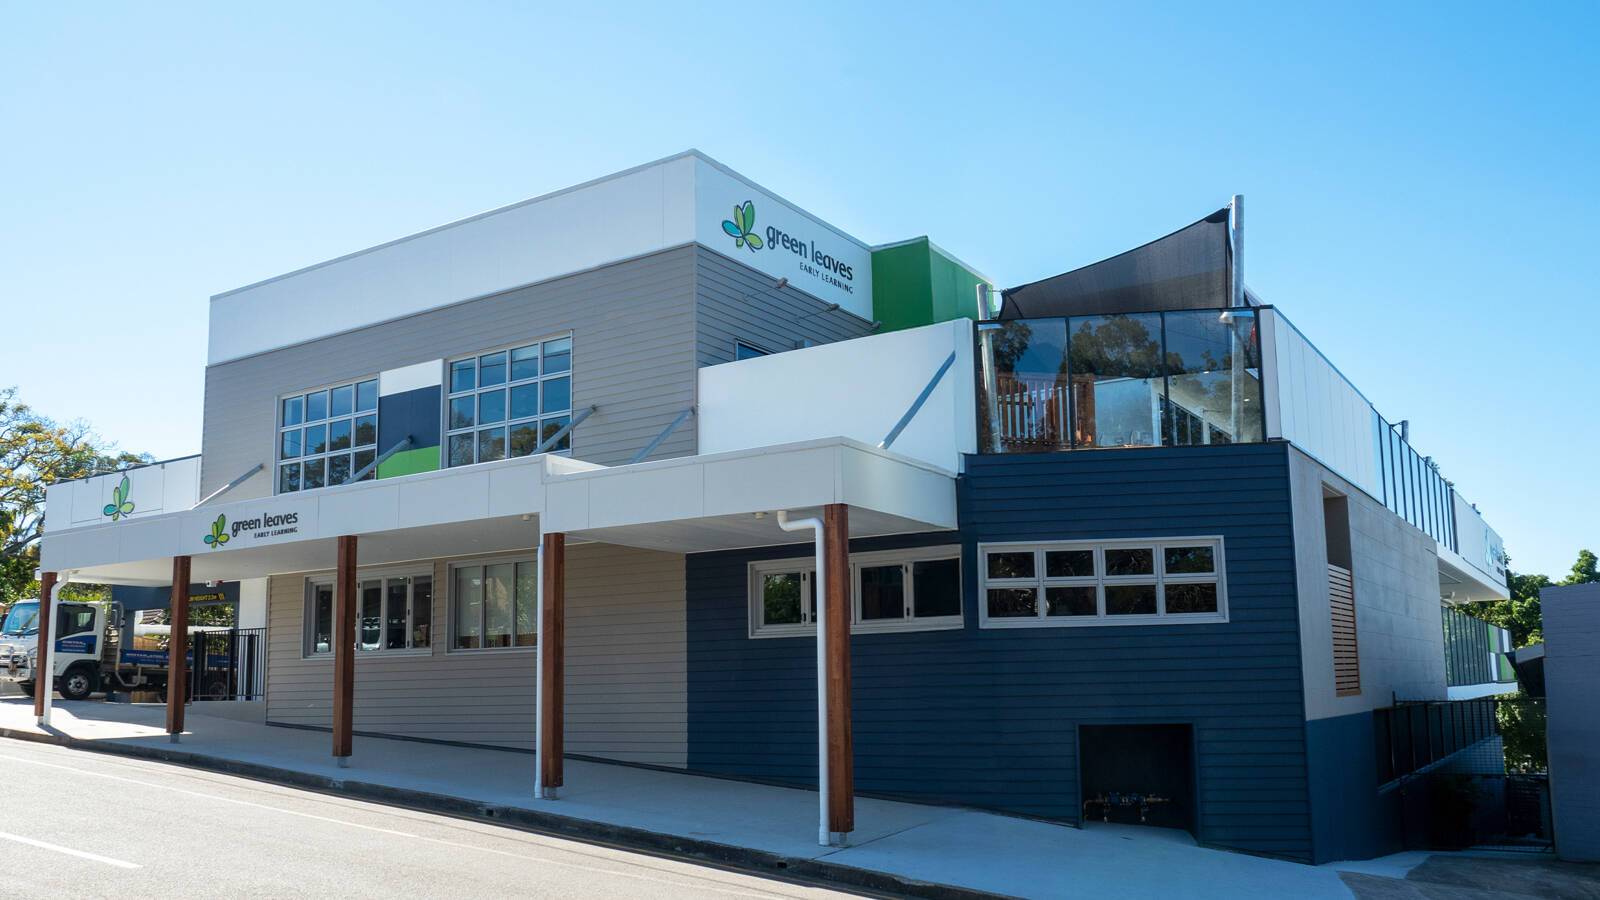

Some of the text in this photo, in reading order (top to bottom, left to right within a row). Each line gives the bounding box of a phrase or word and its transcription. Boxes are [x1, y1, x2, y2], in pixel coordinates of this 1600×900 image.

[766, 225, 853, 281] green leaves
[800, 262, 853, 294] EARLY LEARNING
[231, 512, 298, 538] green leaves
[271, 527, 298, 536] LEARNING
